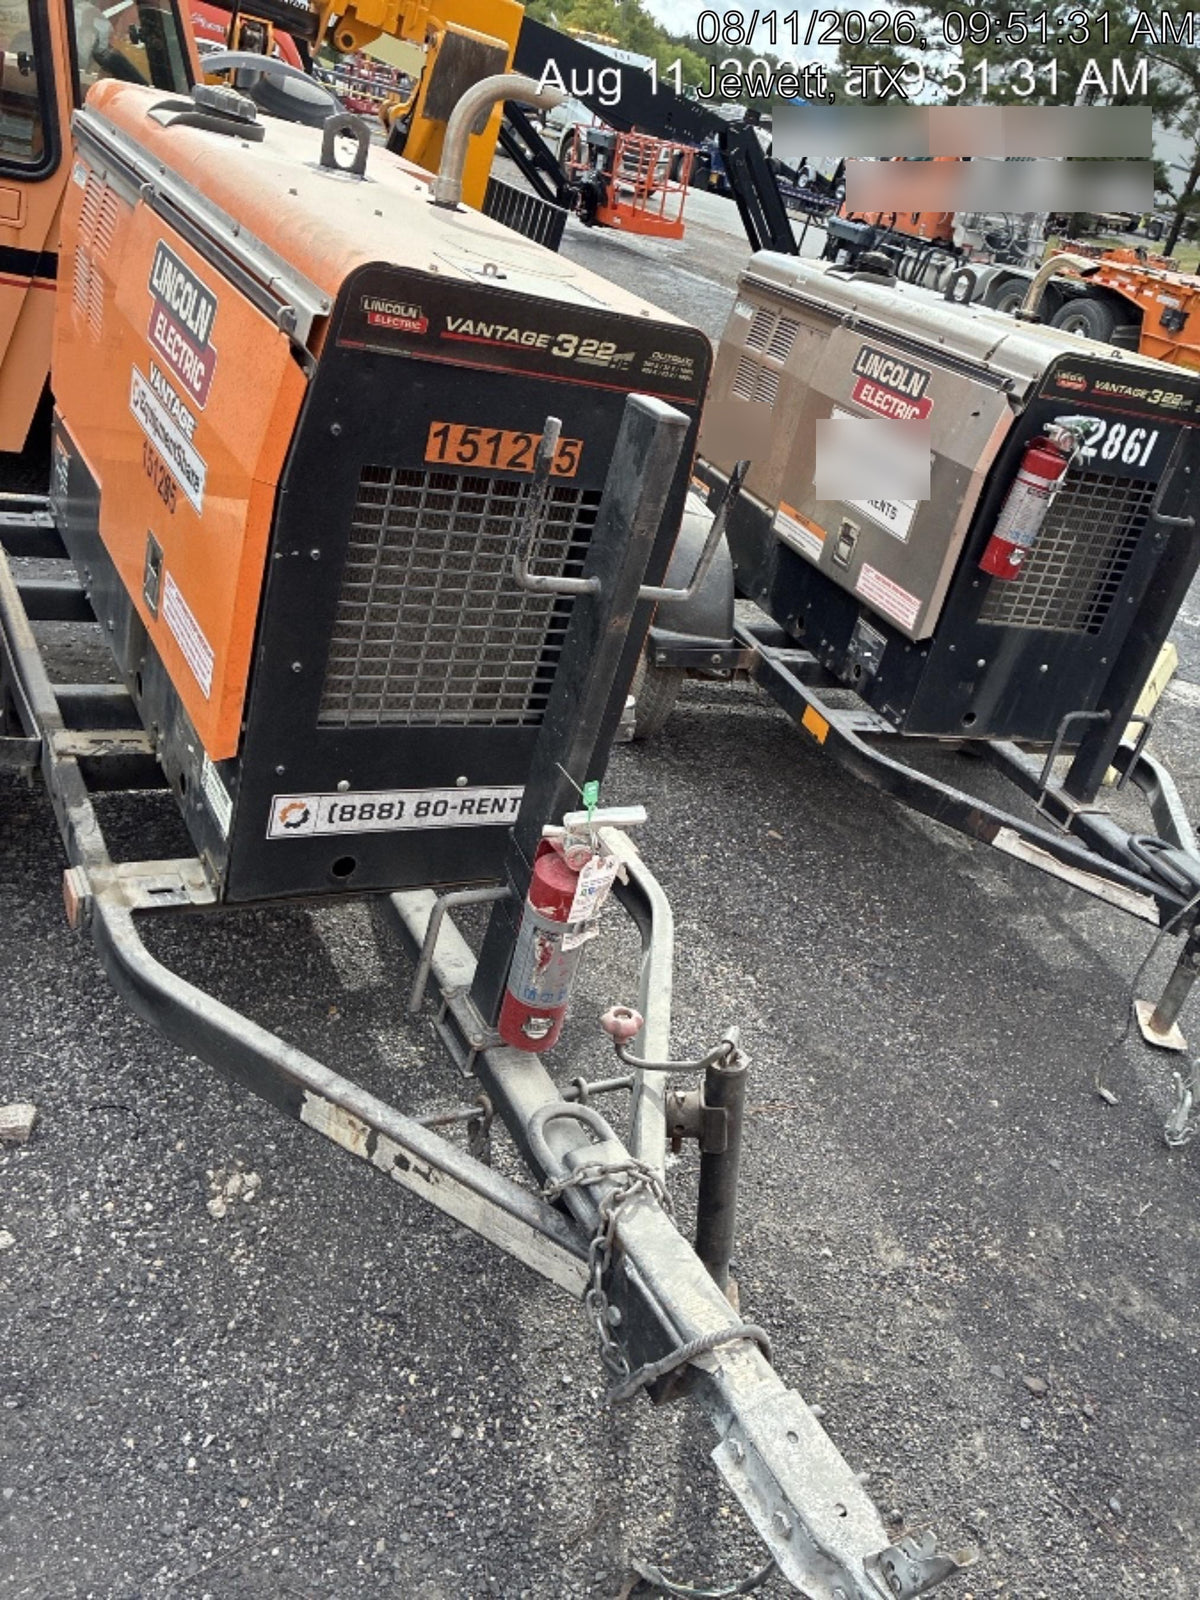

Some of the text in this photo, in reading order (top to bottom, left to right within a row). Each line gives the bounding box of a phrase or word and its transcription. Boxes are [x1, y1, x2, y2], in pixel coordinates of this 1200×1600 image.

[152, 251, 212, 343] LINCOLN
[363, 298, 419, 318] LINCOLN
[374, 314, 422, 330] ELECTRIC
[446, 316, 617, 361] VANTAGE 322
[154, 311, 206, 392] ELECTRIC
[856, 350, 926, 397] LINCOLN
[150, 360, 197, 440] VANTAGE
[1095, 380, 1148, 399] VANTAGE
[433, 425, 578, 473] 15125
[1081, 419, 1159, 467] 2861
[327, 802, 404, 824] (888)
